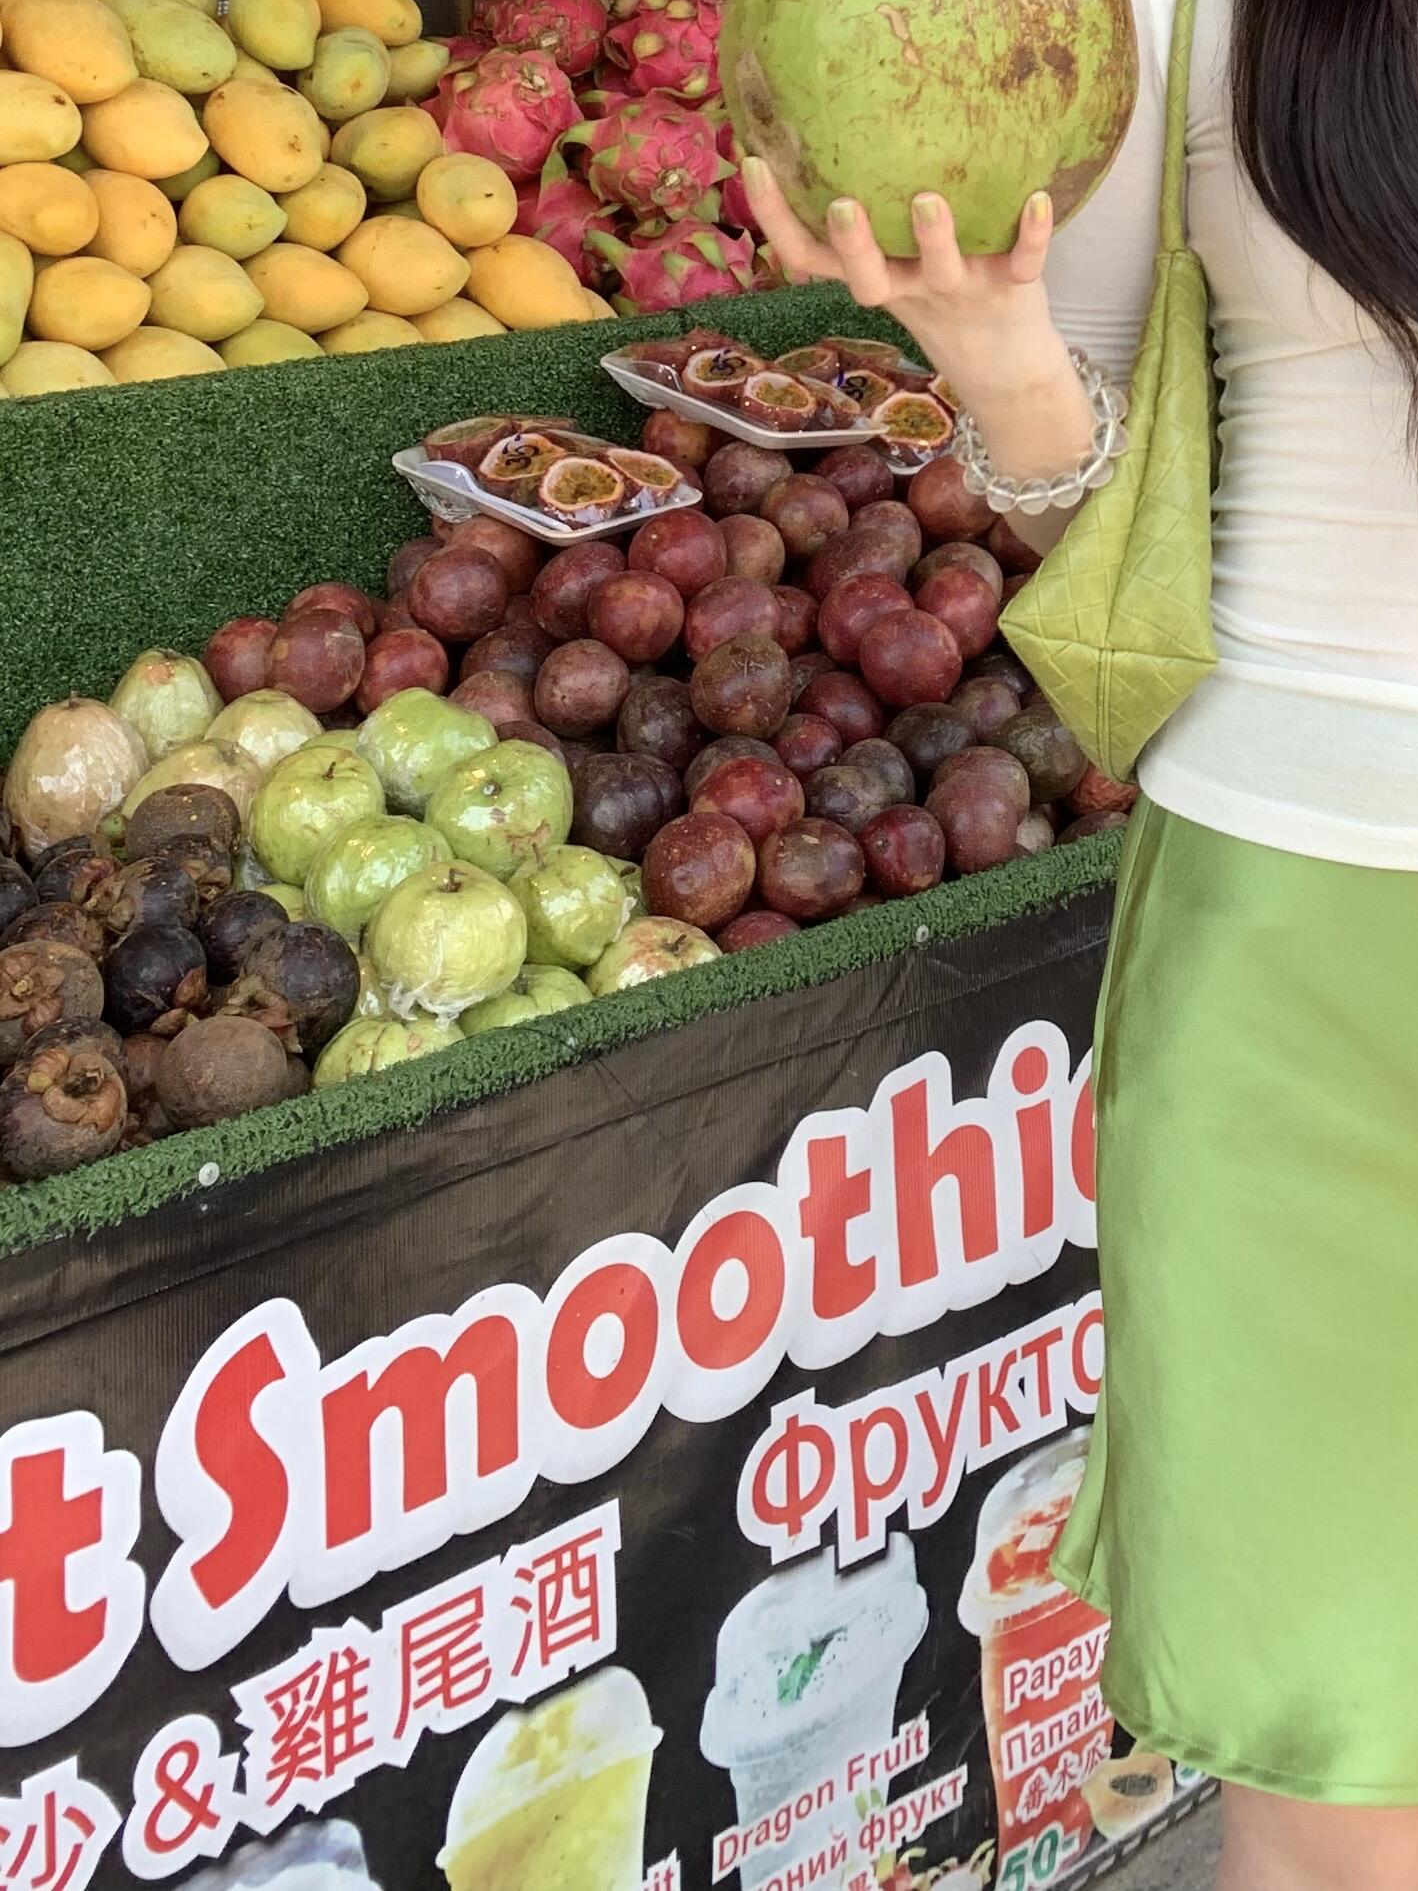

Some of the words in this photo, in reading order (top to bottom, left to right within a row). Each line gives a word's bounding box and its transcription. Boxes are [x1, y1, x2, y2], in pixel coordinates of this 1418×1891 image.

[143, 1739, 221, 1854] &
[264, 1526, 605, 1808] 雞尾酒
[1009, 1628, 1110, 1705] Papay
[718, 1779, 835, 1873] Dragon
[847, 1724, 927, 1793] Fruit
[858, 1776, 965, 1855] фрукт
